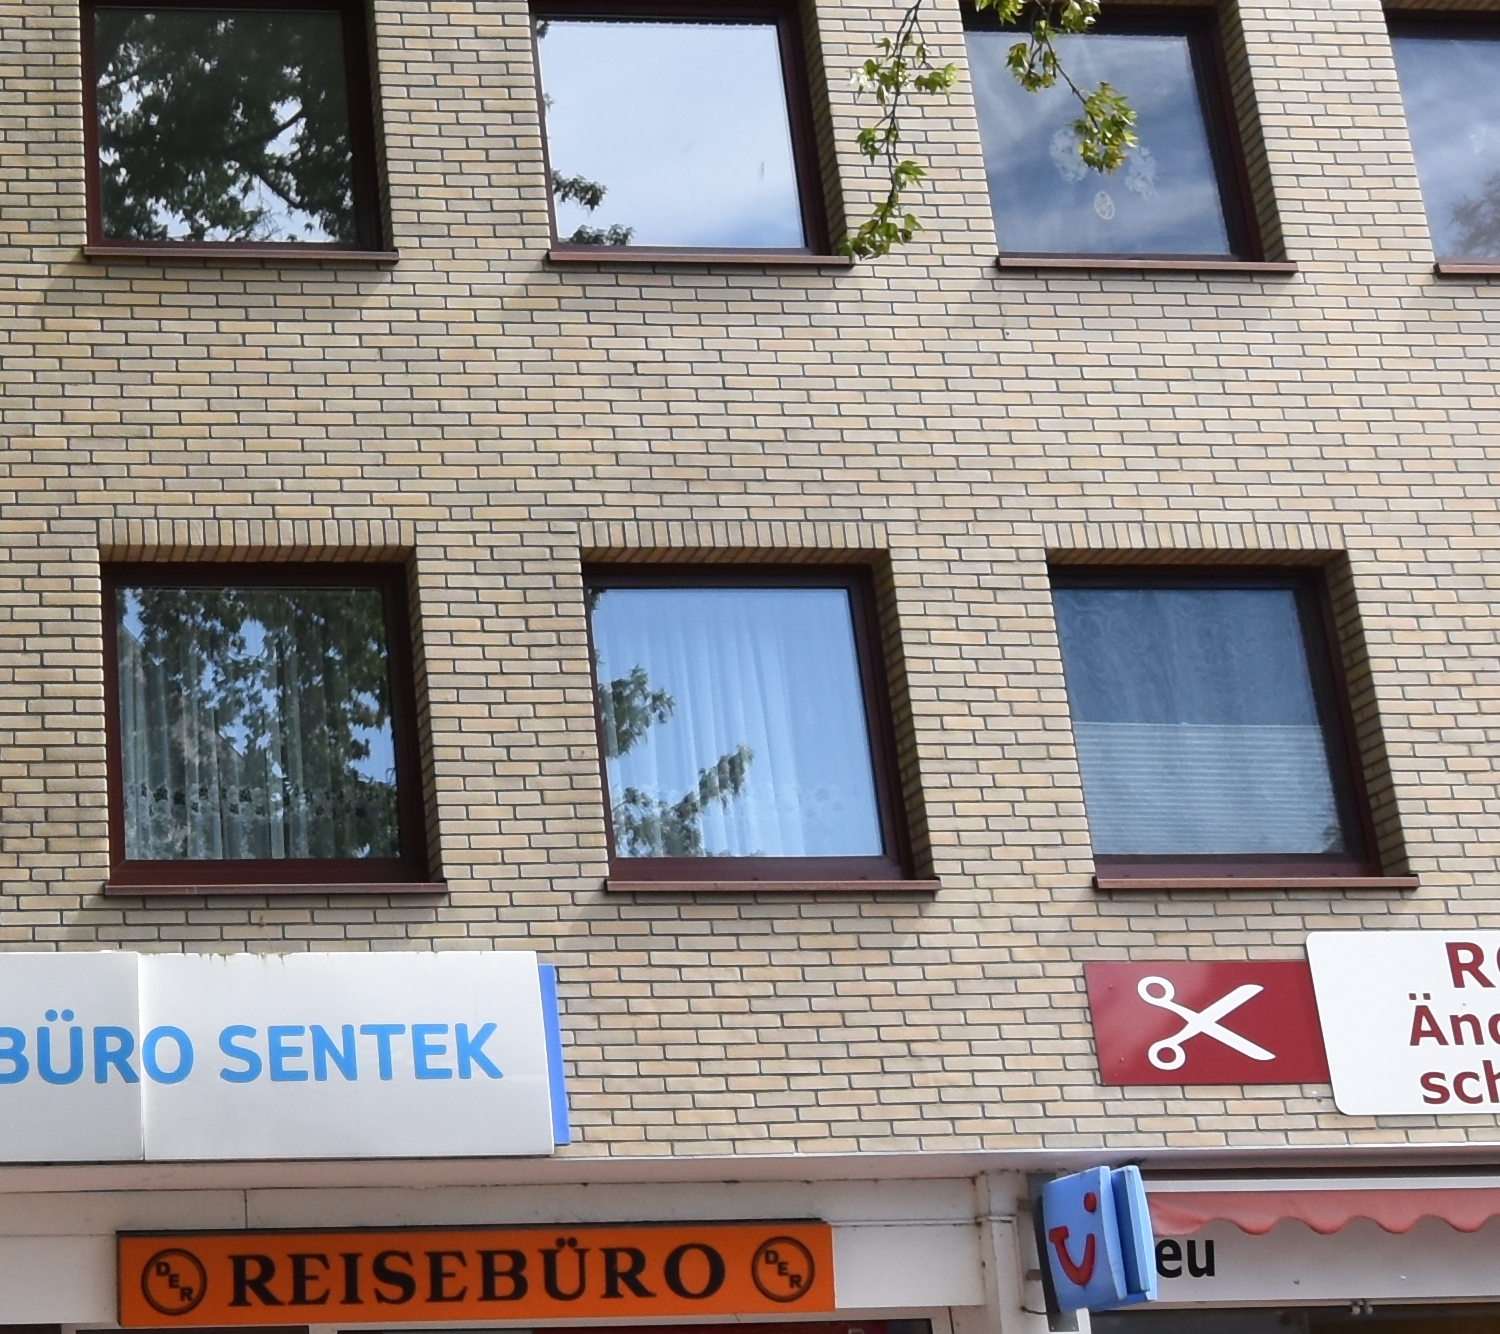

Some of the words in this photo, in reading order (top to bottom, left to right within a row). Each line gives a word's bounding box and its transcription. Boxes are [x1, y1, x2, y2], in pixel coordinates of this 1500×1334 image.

[218, 1021, 505, 1083] SENTEK
[228, 1237, 727, 1308] REISEBÜRO
[1154, 1238, 1216, 1279] eu
